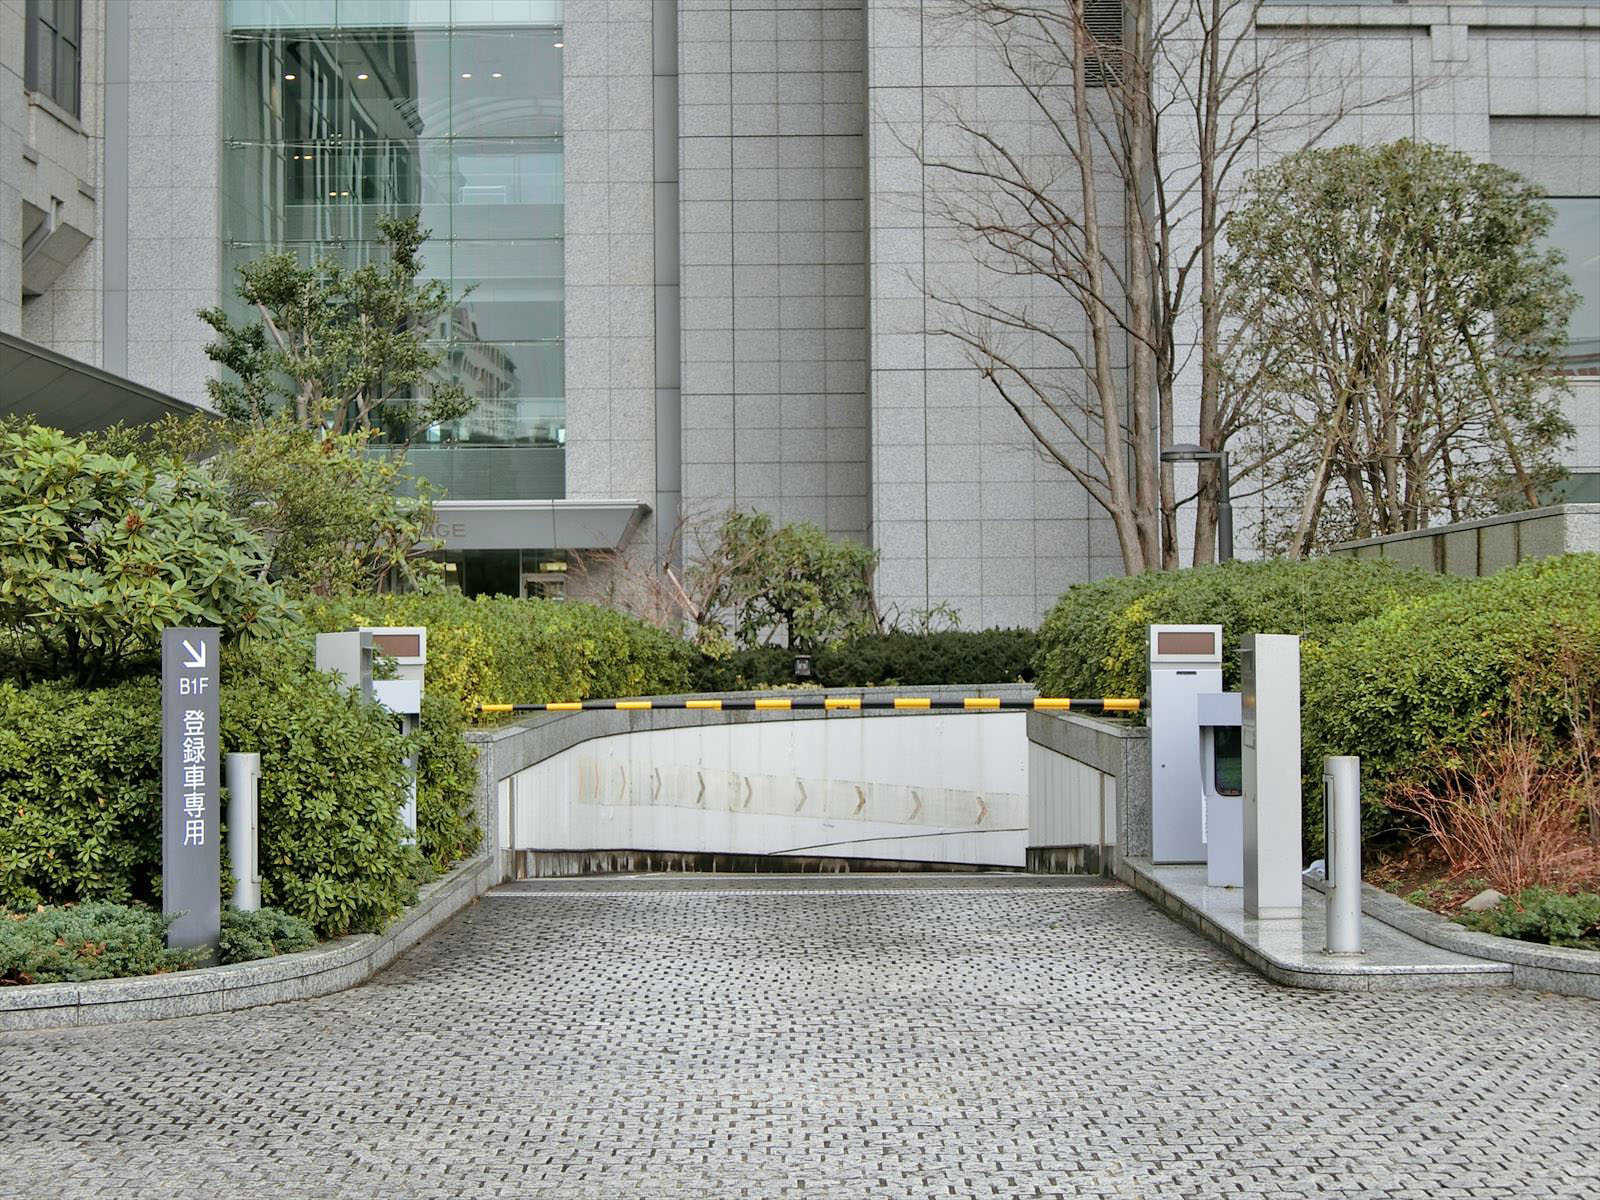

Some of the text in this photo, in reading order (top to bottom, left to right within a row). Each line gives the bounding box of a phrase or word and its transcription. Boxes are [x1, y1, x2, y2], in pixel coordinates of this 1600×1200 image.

[179, 677, 209, 695] B1F
[182, 709, 206, 846] 登録車専用
